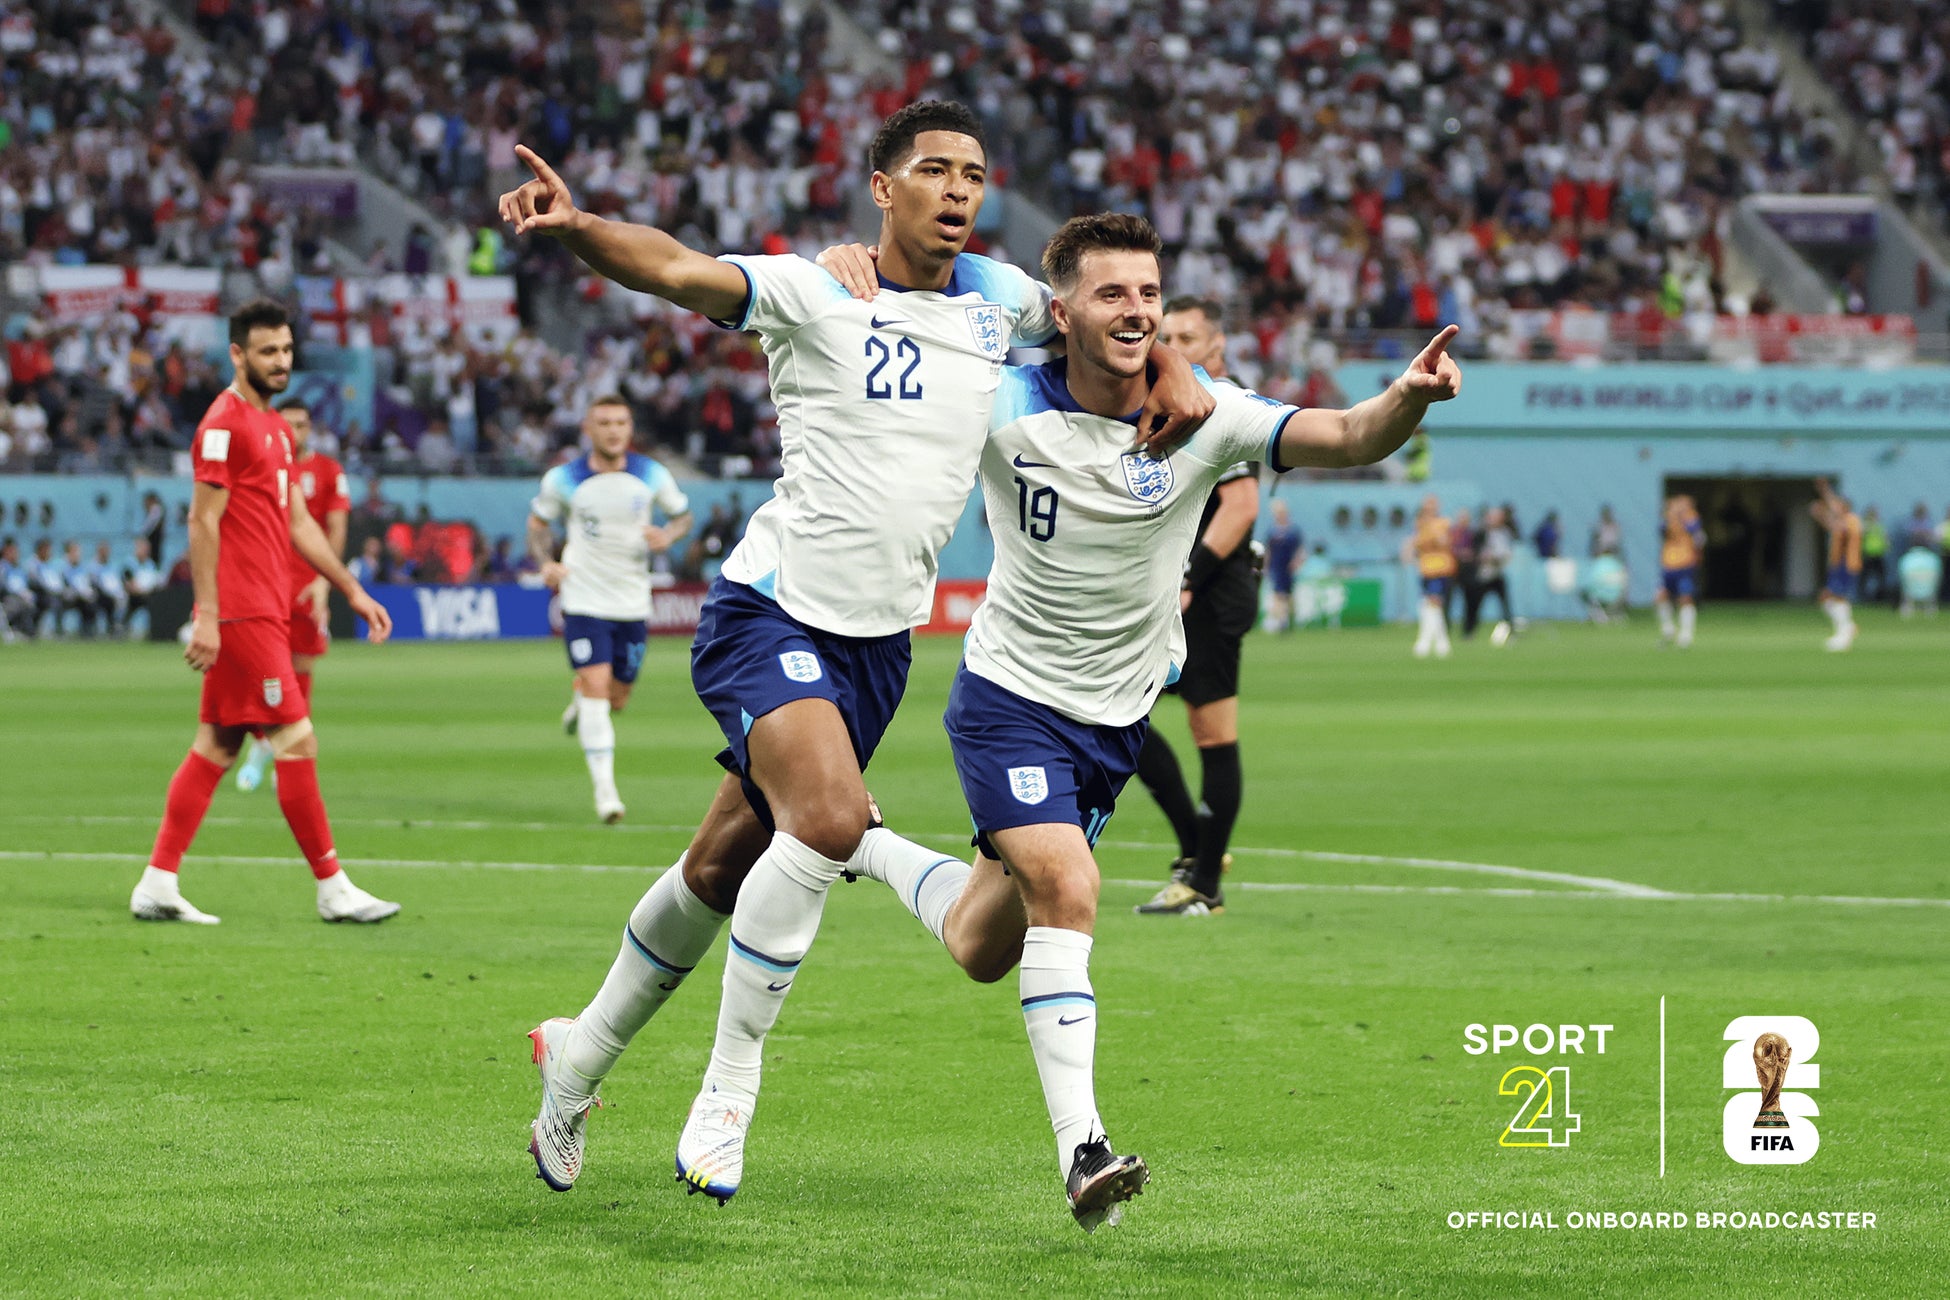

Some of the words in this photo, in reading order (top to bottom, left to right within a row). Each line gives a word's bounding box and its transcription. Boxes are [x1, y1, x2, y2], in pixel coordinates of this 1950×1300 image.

[865, 335, 923, 400] 22
[1014, 476, 1059, 543] 19
[416, 586, 499, 638] VISA
